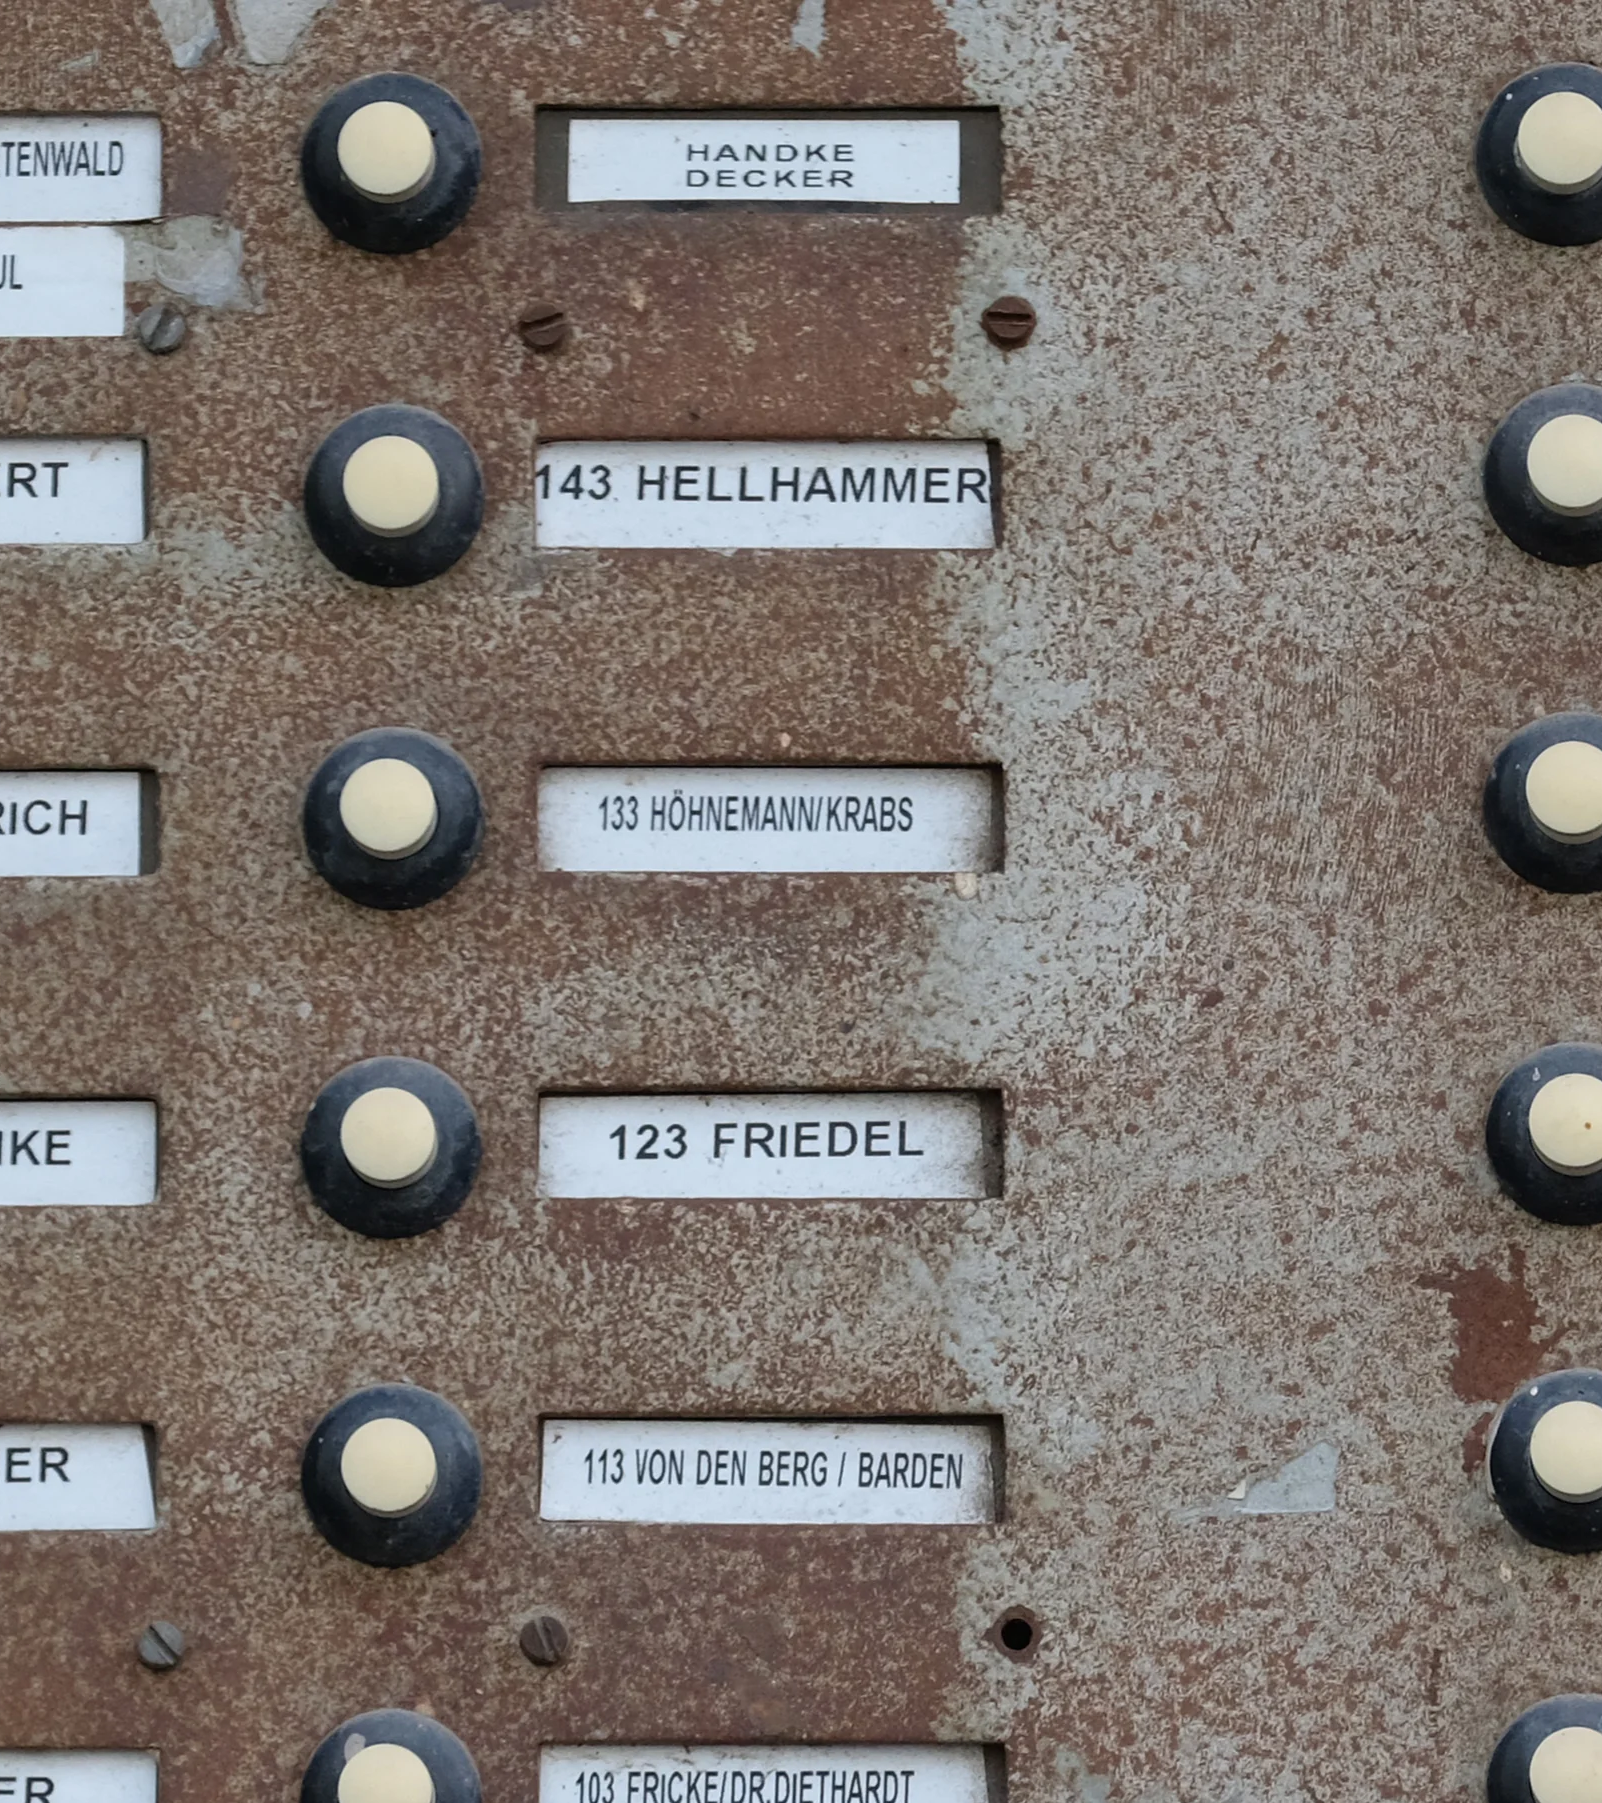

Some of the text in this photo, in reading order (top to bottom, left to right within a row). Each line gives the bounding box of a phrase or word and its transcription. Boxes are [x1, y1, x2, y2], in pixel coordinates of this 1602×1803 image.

[687, 144, 855, 163] HANDKE
[686, 169, 854, 188] DECKER
[534, 464, 991, 502] 143 HELLHAMMER
[598, 789, 914, 832] 133 HÖHNEMANN/KRABS
[609, 1120, 924, 1161] 123 FRIEDEL
[584, 1448, 964, 1490] 113 VON DEN BERG / BARDEN
